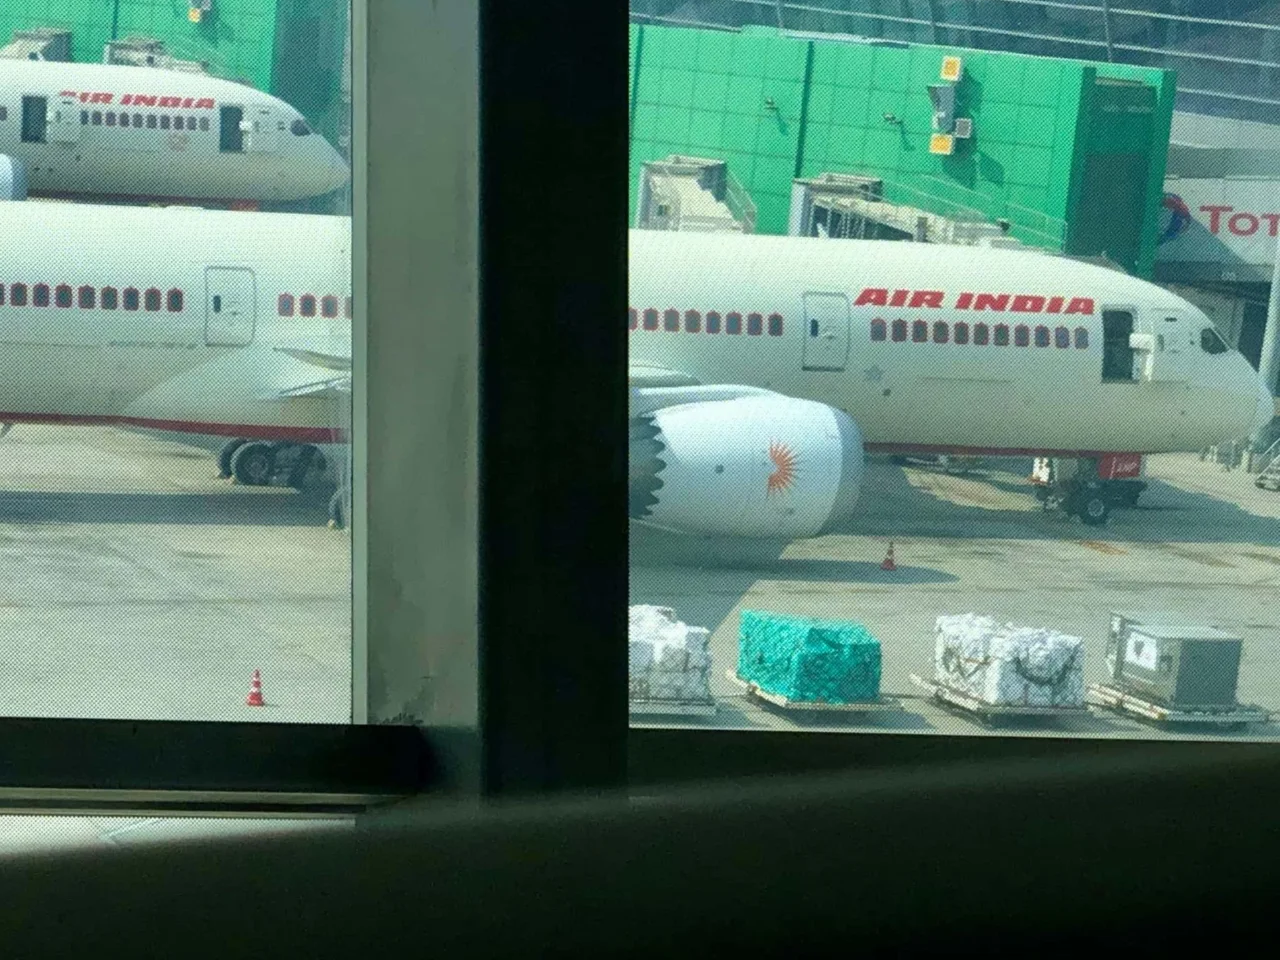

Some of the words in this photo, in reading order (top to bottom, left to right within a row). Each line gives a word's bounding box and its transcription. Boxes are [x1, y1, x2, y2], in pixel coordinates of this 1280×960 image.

[121, 93, 216, 109] INDIA
[854, 288, 945, 309] AIR
[955, 292, 1095, 315] INDIA
